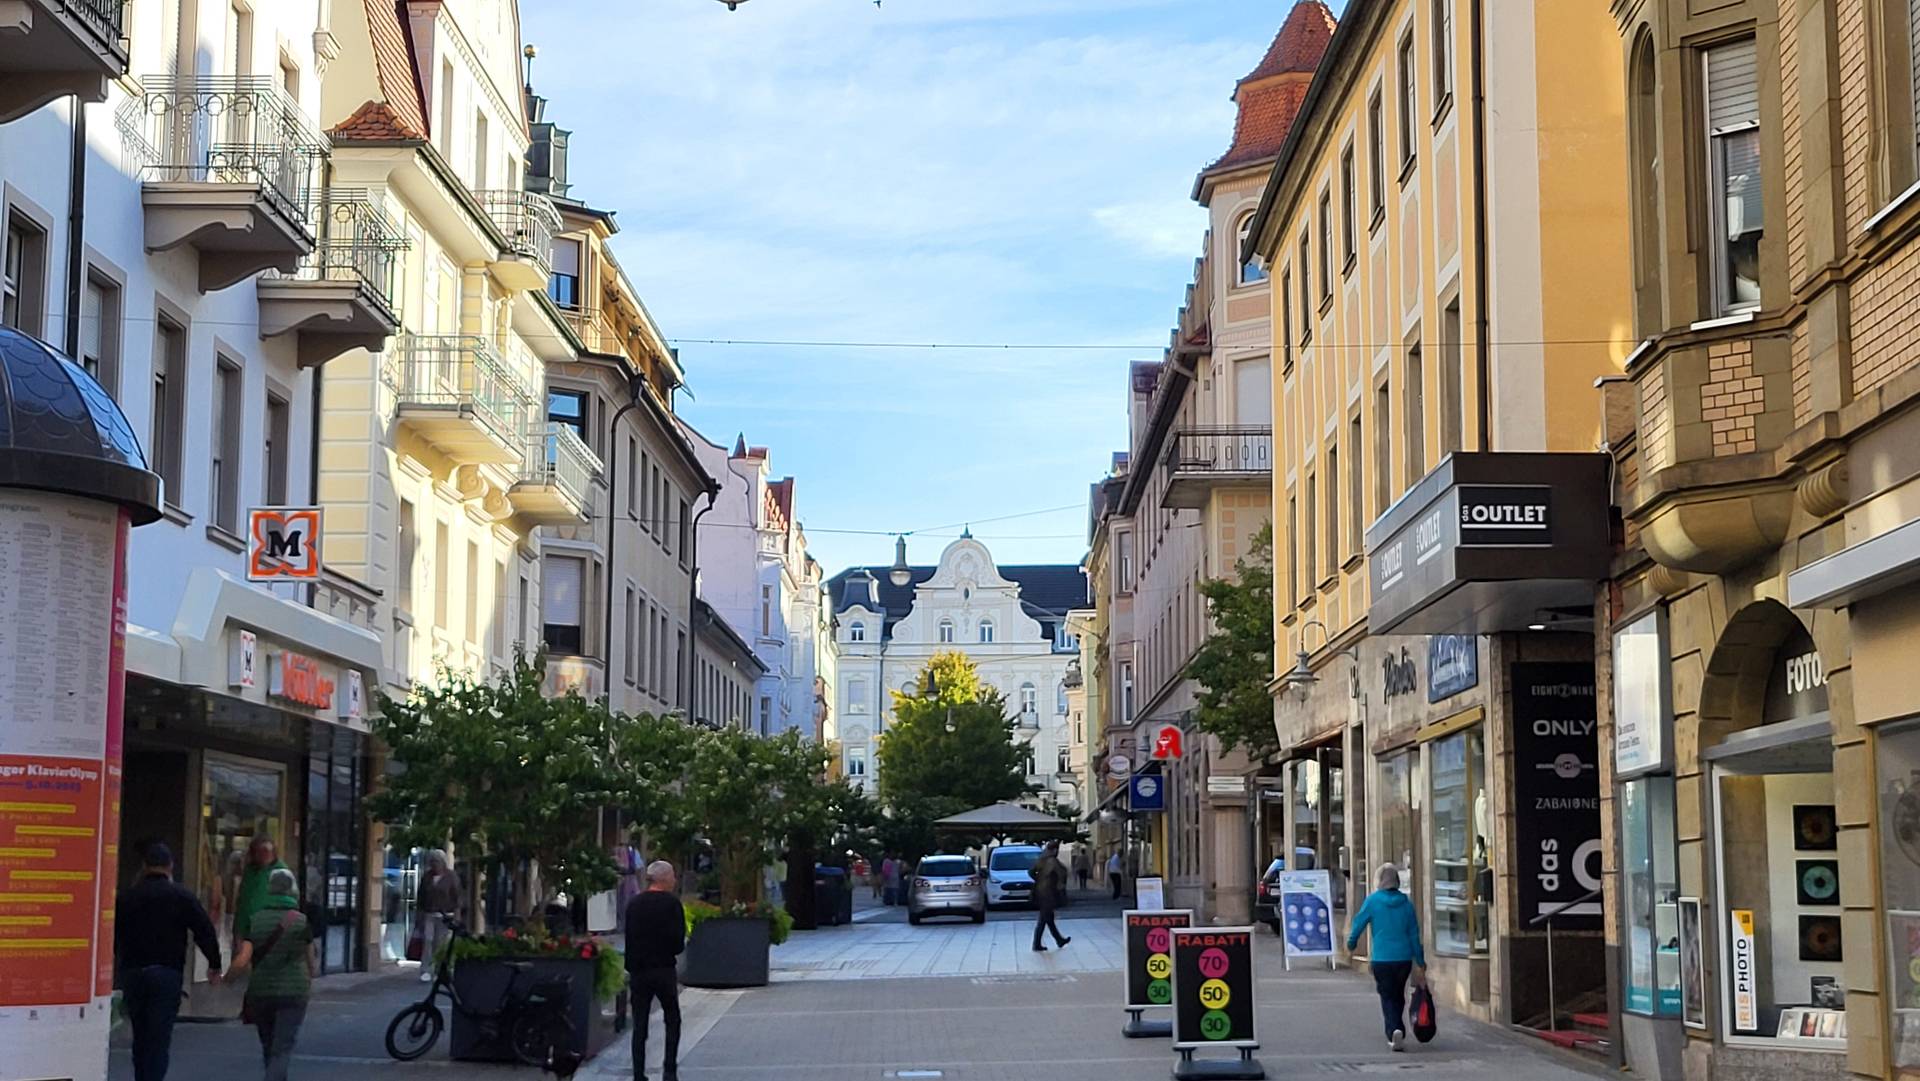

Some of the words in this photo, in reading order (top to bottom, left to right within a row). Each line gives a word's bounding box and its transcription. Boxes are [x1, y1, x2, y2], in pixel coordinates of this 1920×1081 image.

[1461, 505, 1469, 521] das
[1471, 505, 1546, 522] OUTLET
[268, 530, 302, 557] M
[1786, 651, 1828, 695] FOTO
[1533, 719, 1595, 736] ONLY
[1535, 797, 1599, 809] ZABAIONE
[1537, 838, 1560, 892] das
[1128, 915, 1188, 927] RABATT
[1177, 934, 1249, 947] RABATT
